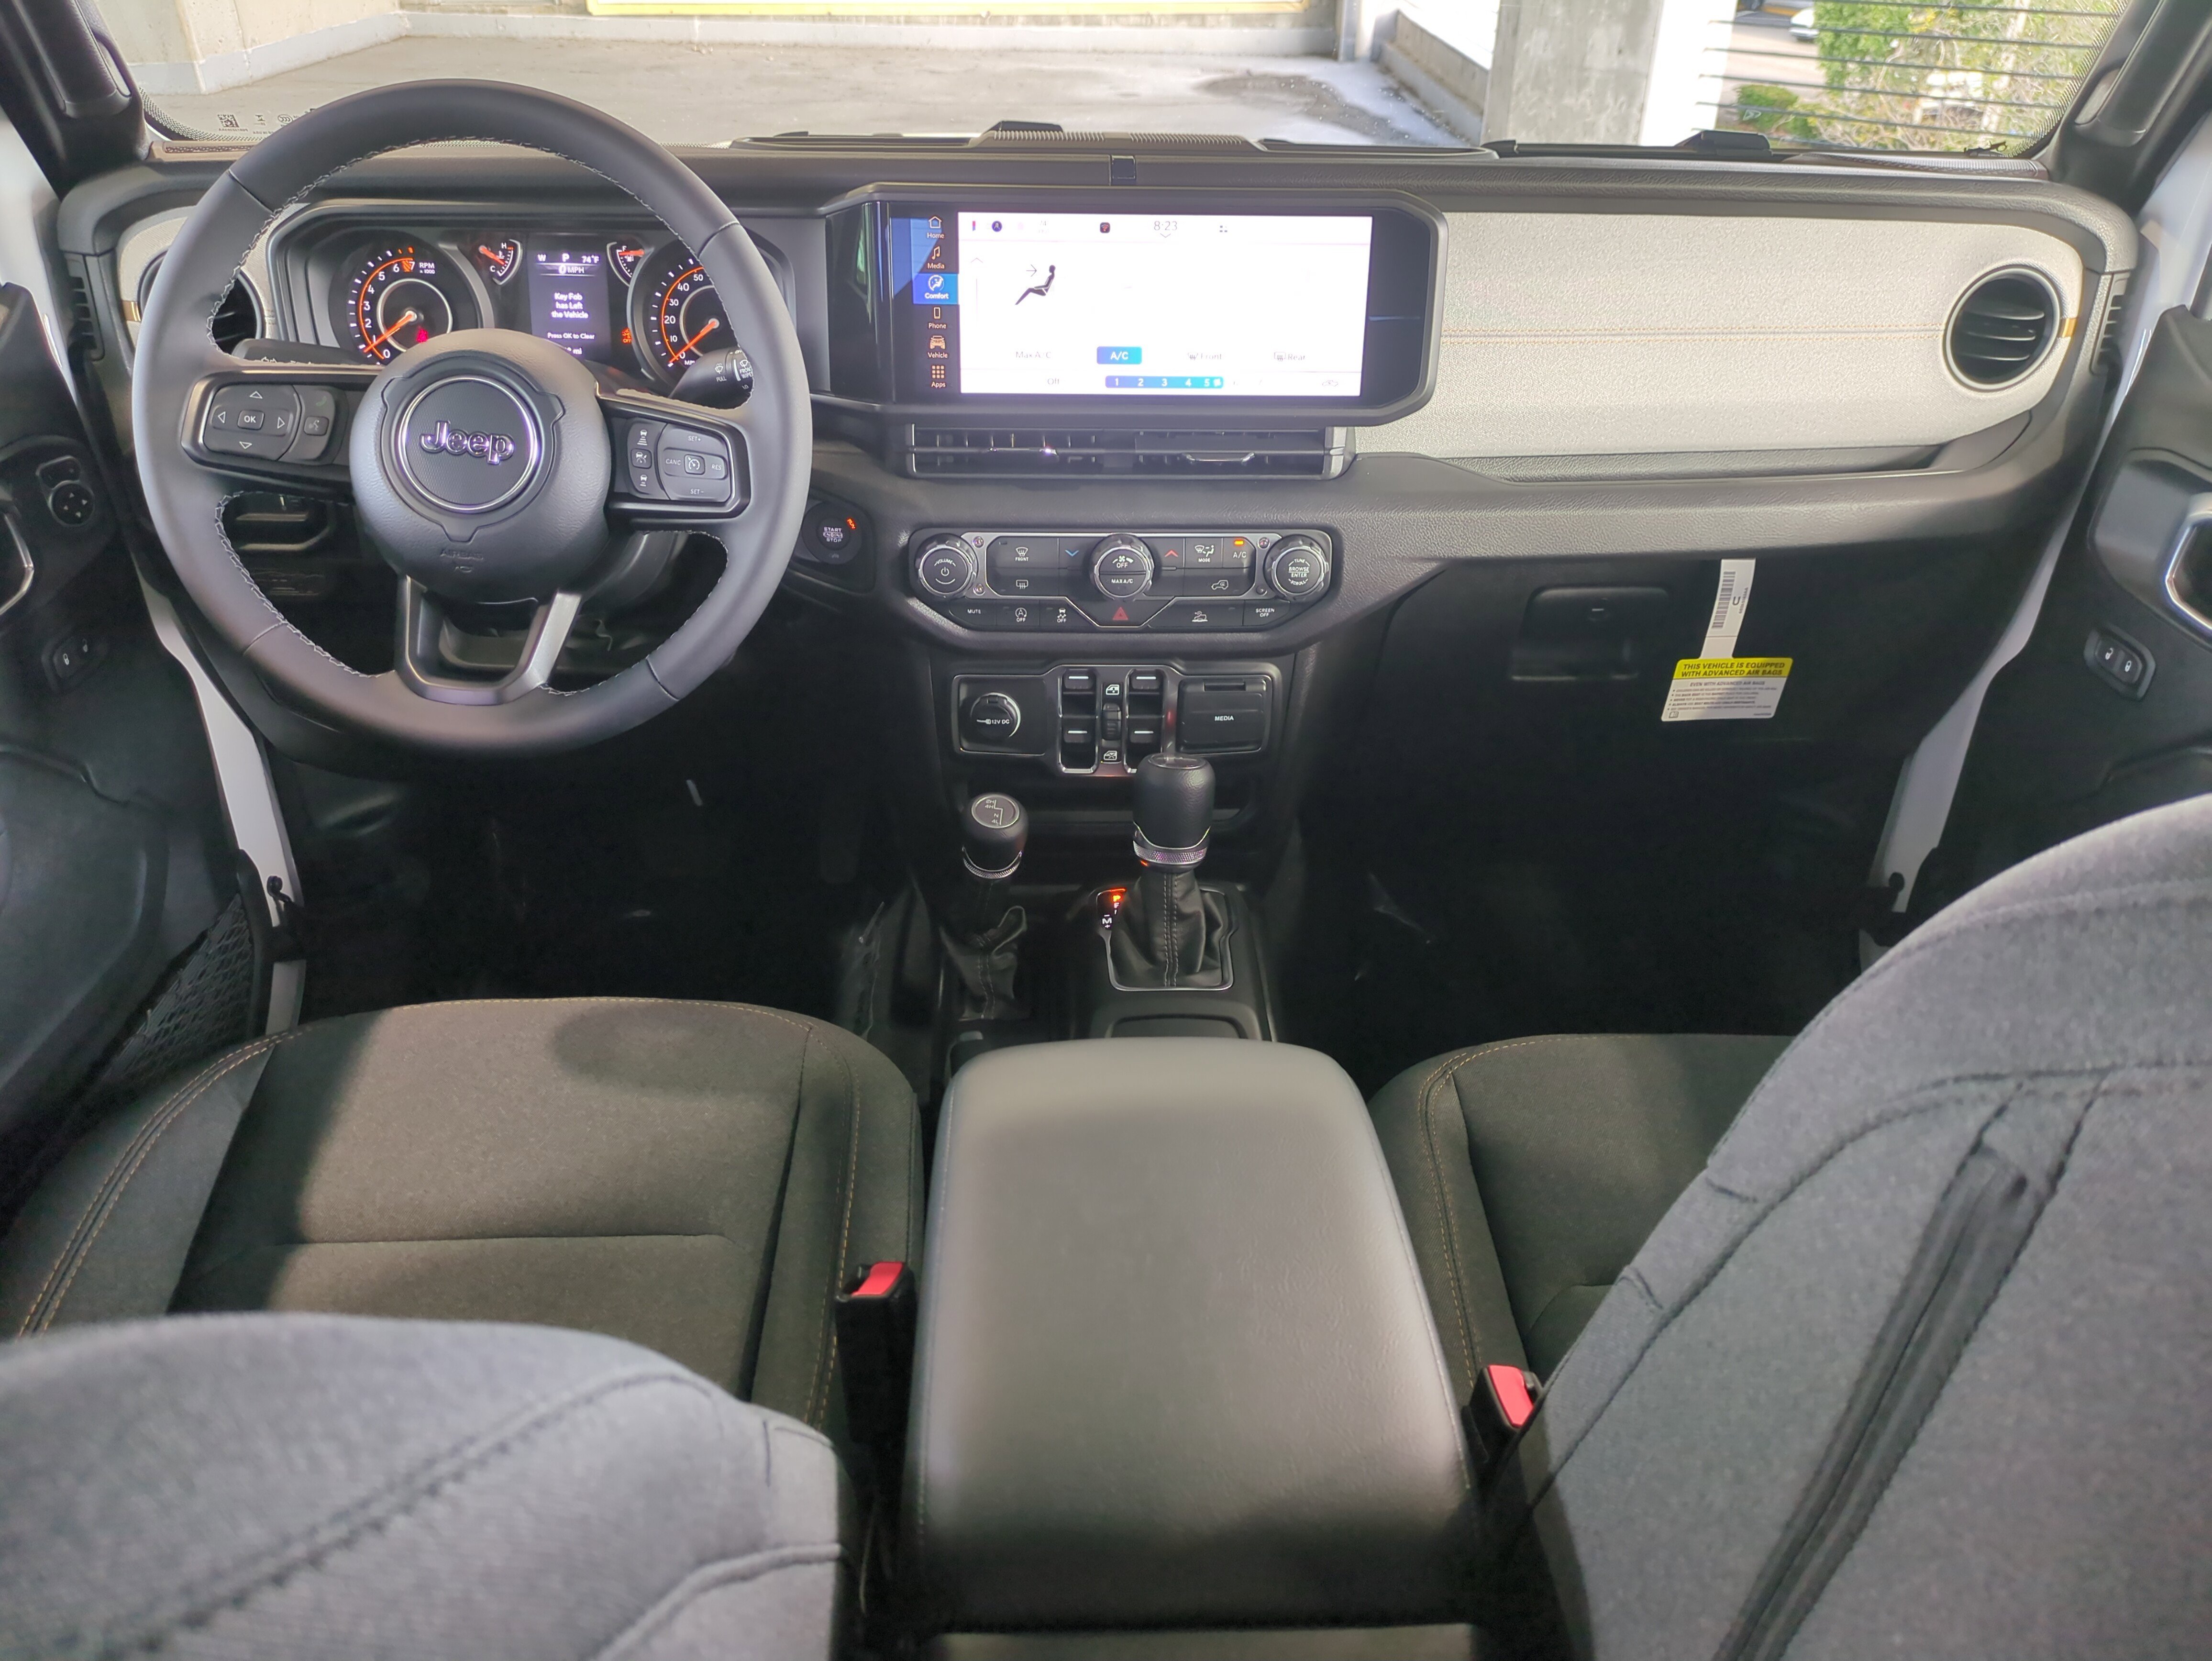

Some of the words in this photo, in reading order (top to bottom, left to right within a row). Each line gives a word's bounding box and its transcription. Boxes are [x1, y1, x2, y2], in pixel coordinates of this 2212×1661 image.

[1154, 221, 1177, 231] 8:23
[562, 253, 570, 262] P
[393, 264, 399, 272] 6
[558, 265, 567, 275] 0
[378, 272, 385, 281] 5
[368, 285, 375, 294] 4
[678, 283, 689, 291] 40
[554, 292, 568, 301] Key
[568, 292, 583, 300] Fob
[364, 301, 370, 310] 3
[555, 301, 568, 309] has
[551, 310, 563, 318] the
[564, 310, 589, 319] Vehicle
[365, 319, 372, 328] 2
[664, 316, 675, 324] 20
[383, 350, 390, 358] 0
[1110, 352, 1129, 360] A/C
[1115, 378, 1119, 386] 1
[1138, 378, 1144, 387] 2
[1161, 378, 1168, 387] 3
[1185, 378, 1192, 387] 4
[1204, 378, 1210, 387] 5
[420, 420, 515, 465] Jeep
